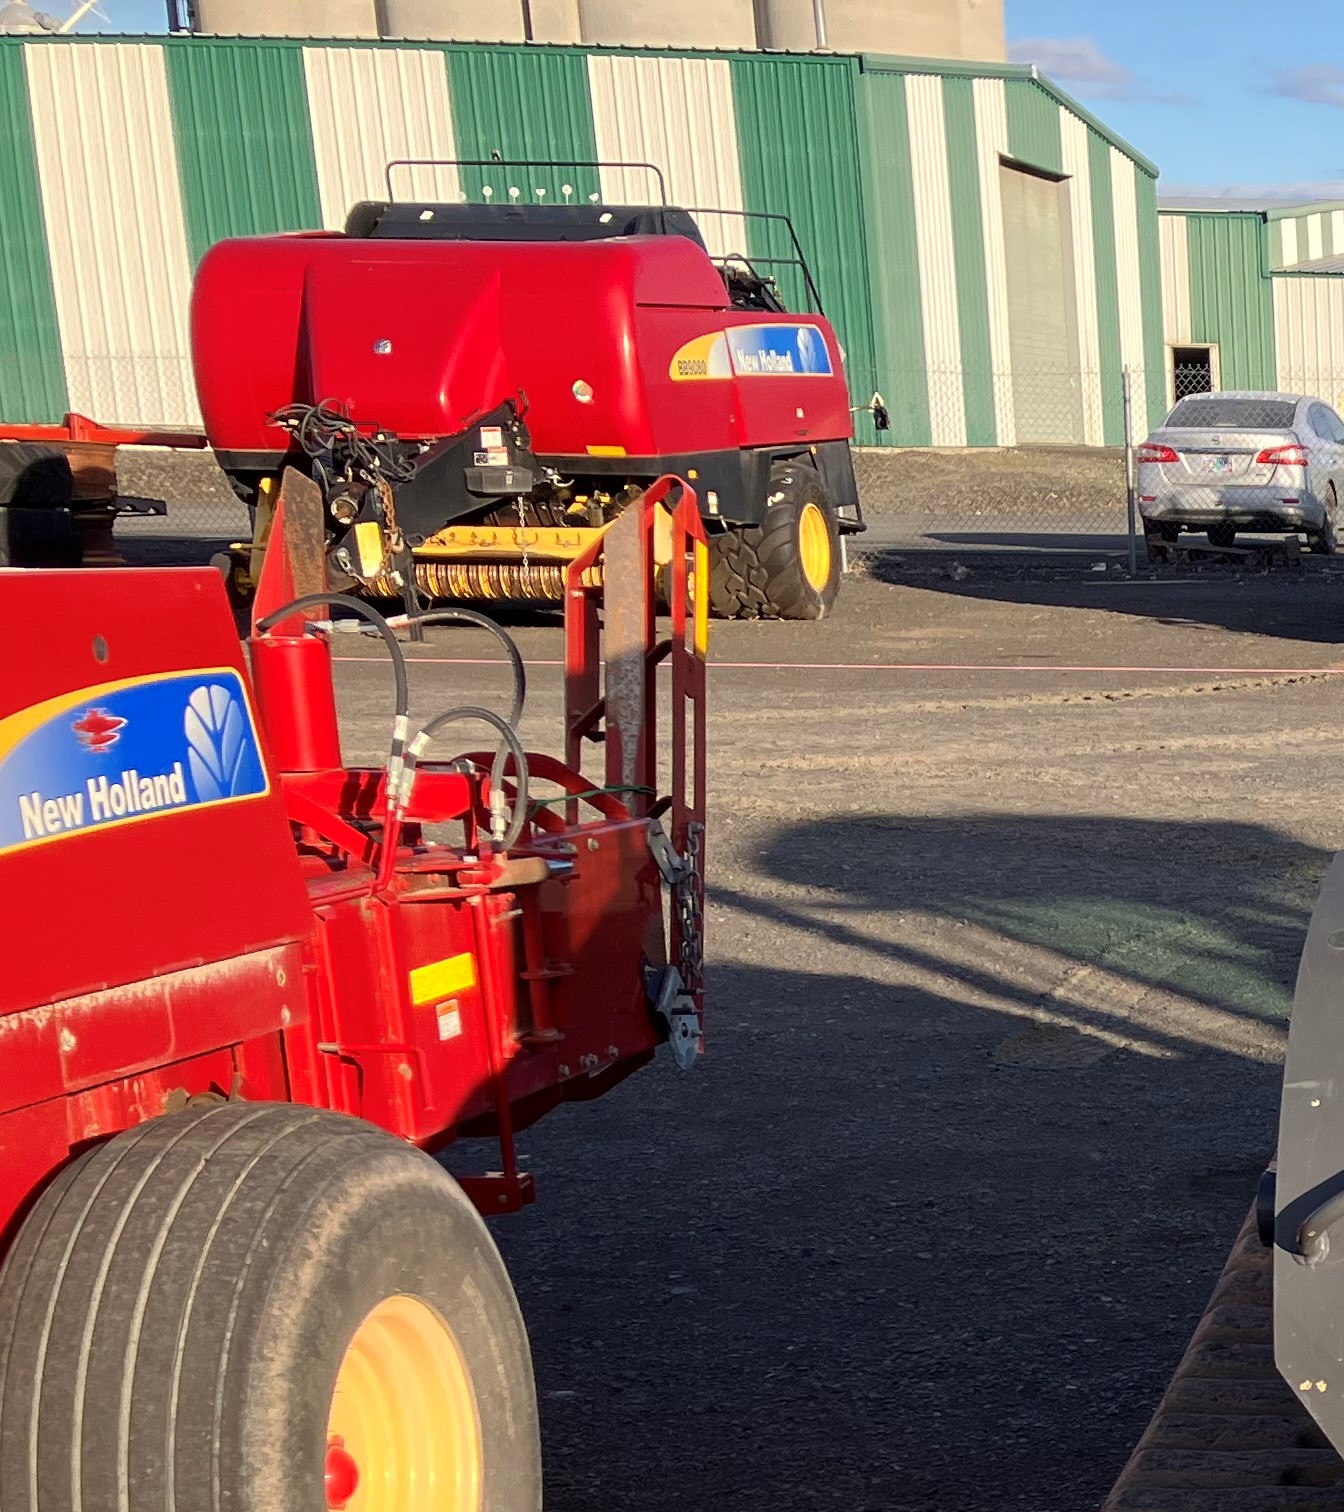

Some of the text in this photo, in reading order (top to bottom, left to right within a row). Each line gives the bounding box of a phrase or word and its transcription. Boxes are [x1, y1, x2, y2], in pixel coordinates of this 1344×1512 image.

[736, 349, 794, 372] New Holland
[18, 761, 187, 840] New Holland
